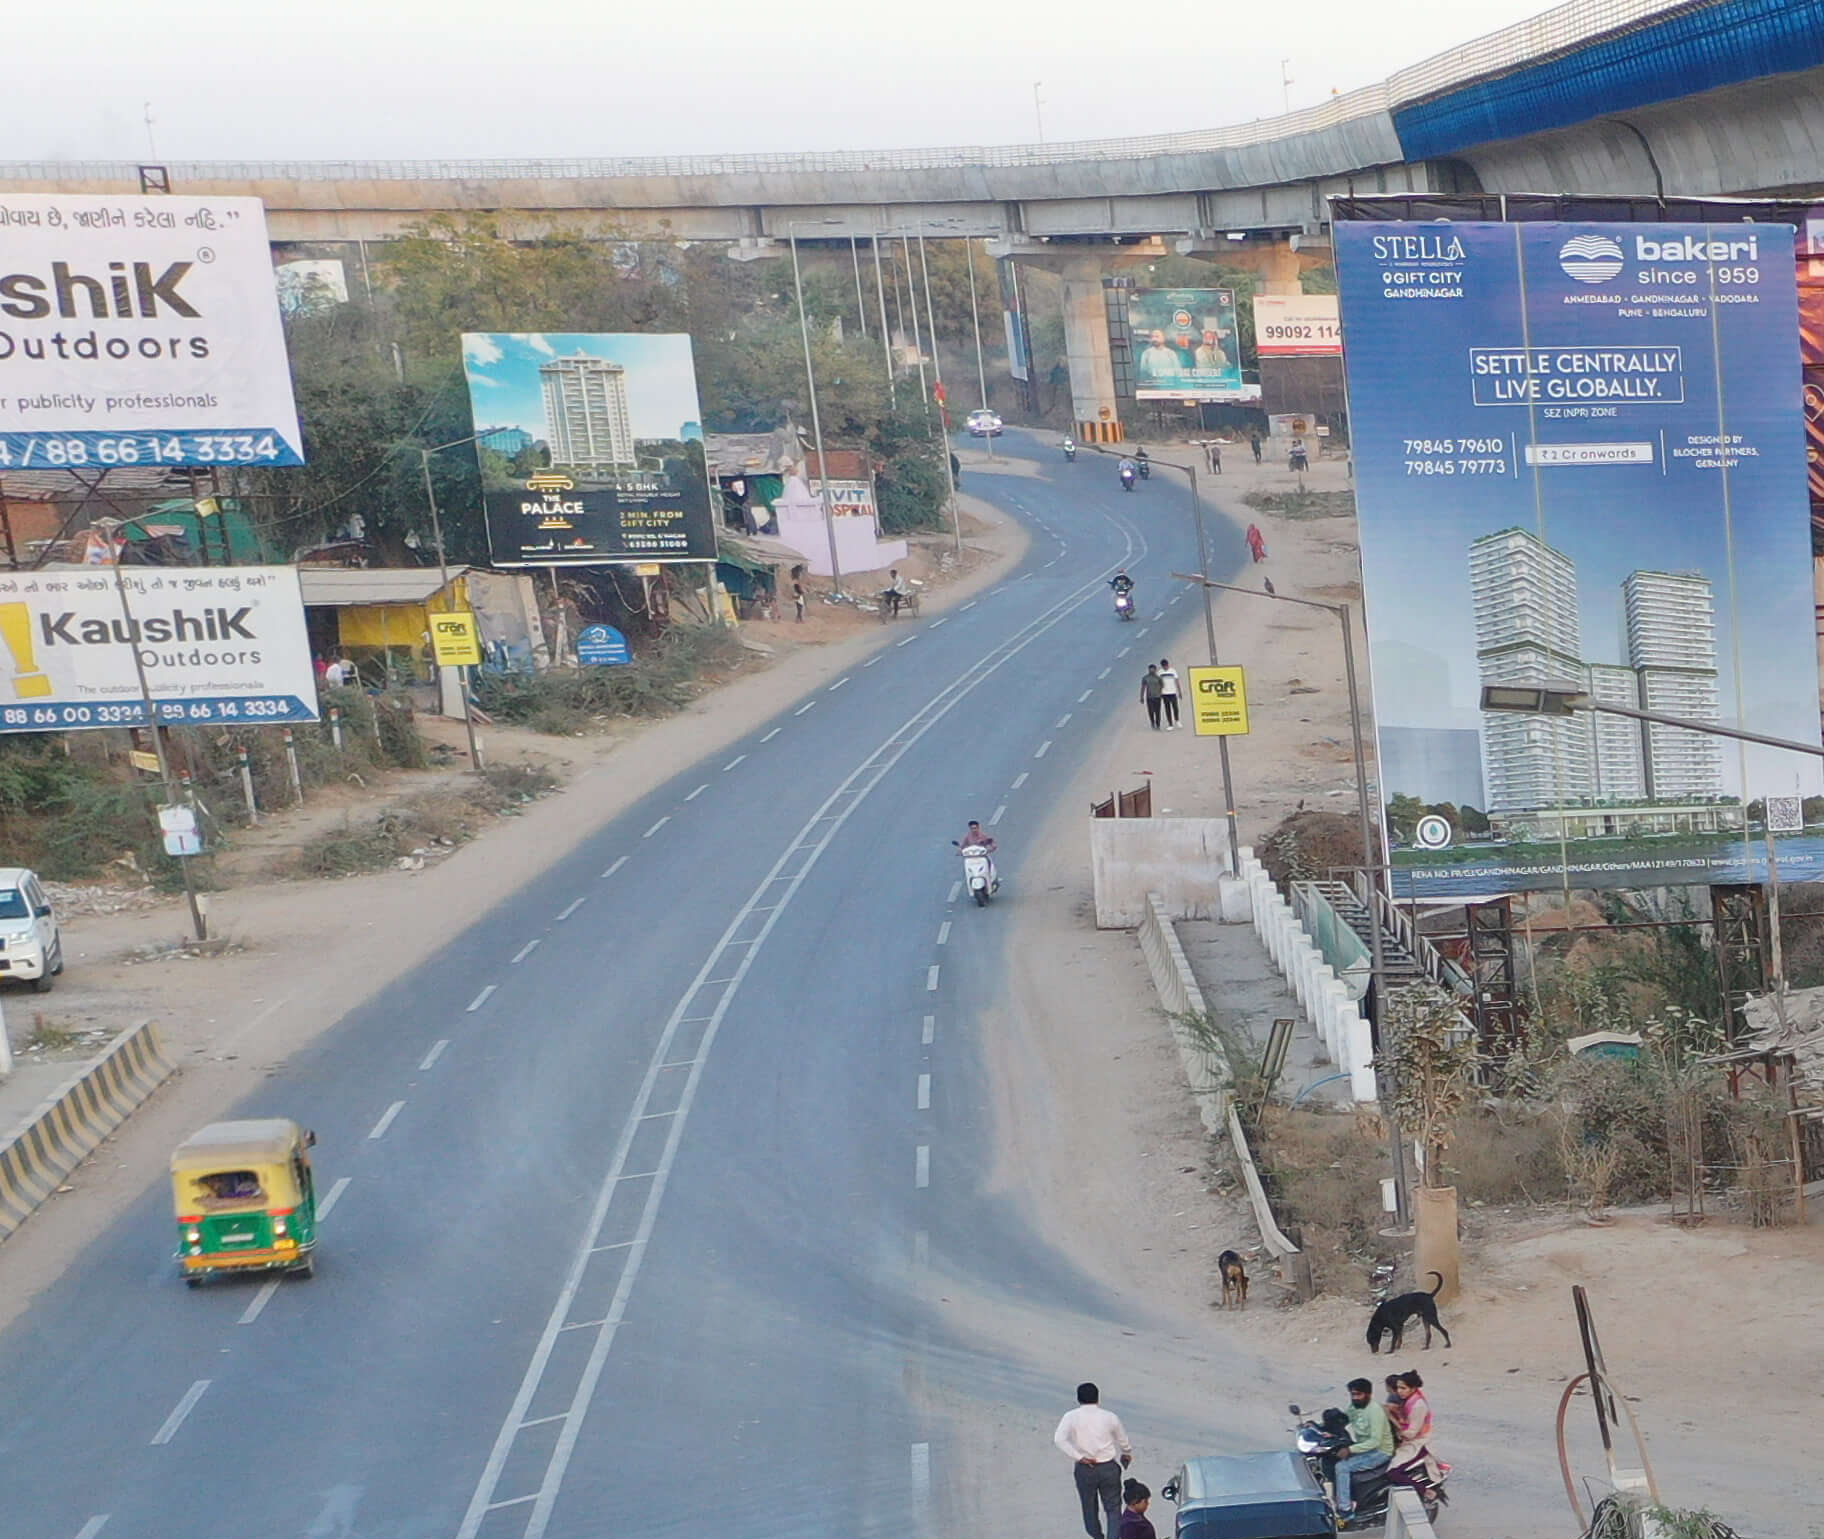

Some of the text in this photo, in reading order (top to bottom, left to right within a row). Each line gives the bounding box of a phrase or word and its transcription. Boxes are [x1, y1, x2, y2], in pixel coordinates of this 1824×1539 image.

[1373, 236, 1466, 261] STELLA
[1636, 235, 1759, 261] bakeri
[1394, 272, 1463, 284] GIFT CITY
[1638, 267, 1760, 285] since 1959
[1384, 287, 1465, 299] GANDHINAGAR
[1266, 326, 1312, 339] 99092
[1475, 353, 1677, 375] SETTLE CENTRALLY
[1495, 378, 1663, 399] LIVE GLOBALLY.
[18, 393, 95, 414] publicity
[1591, 407, 1617, 417] ZONE
[46, 438, 89, 463] 88
[99, 439, 140, 463] 66
[147, 438, 185, 462] 14
[191, 436, 278, 461] 3334
[1403, 438, 1504, 455] 79845 79610
[1404, 459, 1506, 476] 79845 79773
[542, 494, 561, 502] THE
[521, 502, 584, 514] PALACE
[647, 520, 670, 528] CITY
[40, 606, 257, 646] KaushiK
[138, 648, 262, 668] Outdoors
[5, 708, 28, 724] 88
[34, 707, 57, 723] 66
[63, 706, 92, 723] 00
[190, 703, 213, 719] 66
[218, 701, 239, 716] 14
[244, 699, 290, 716] 3334
